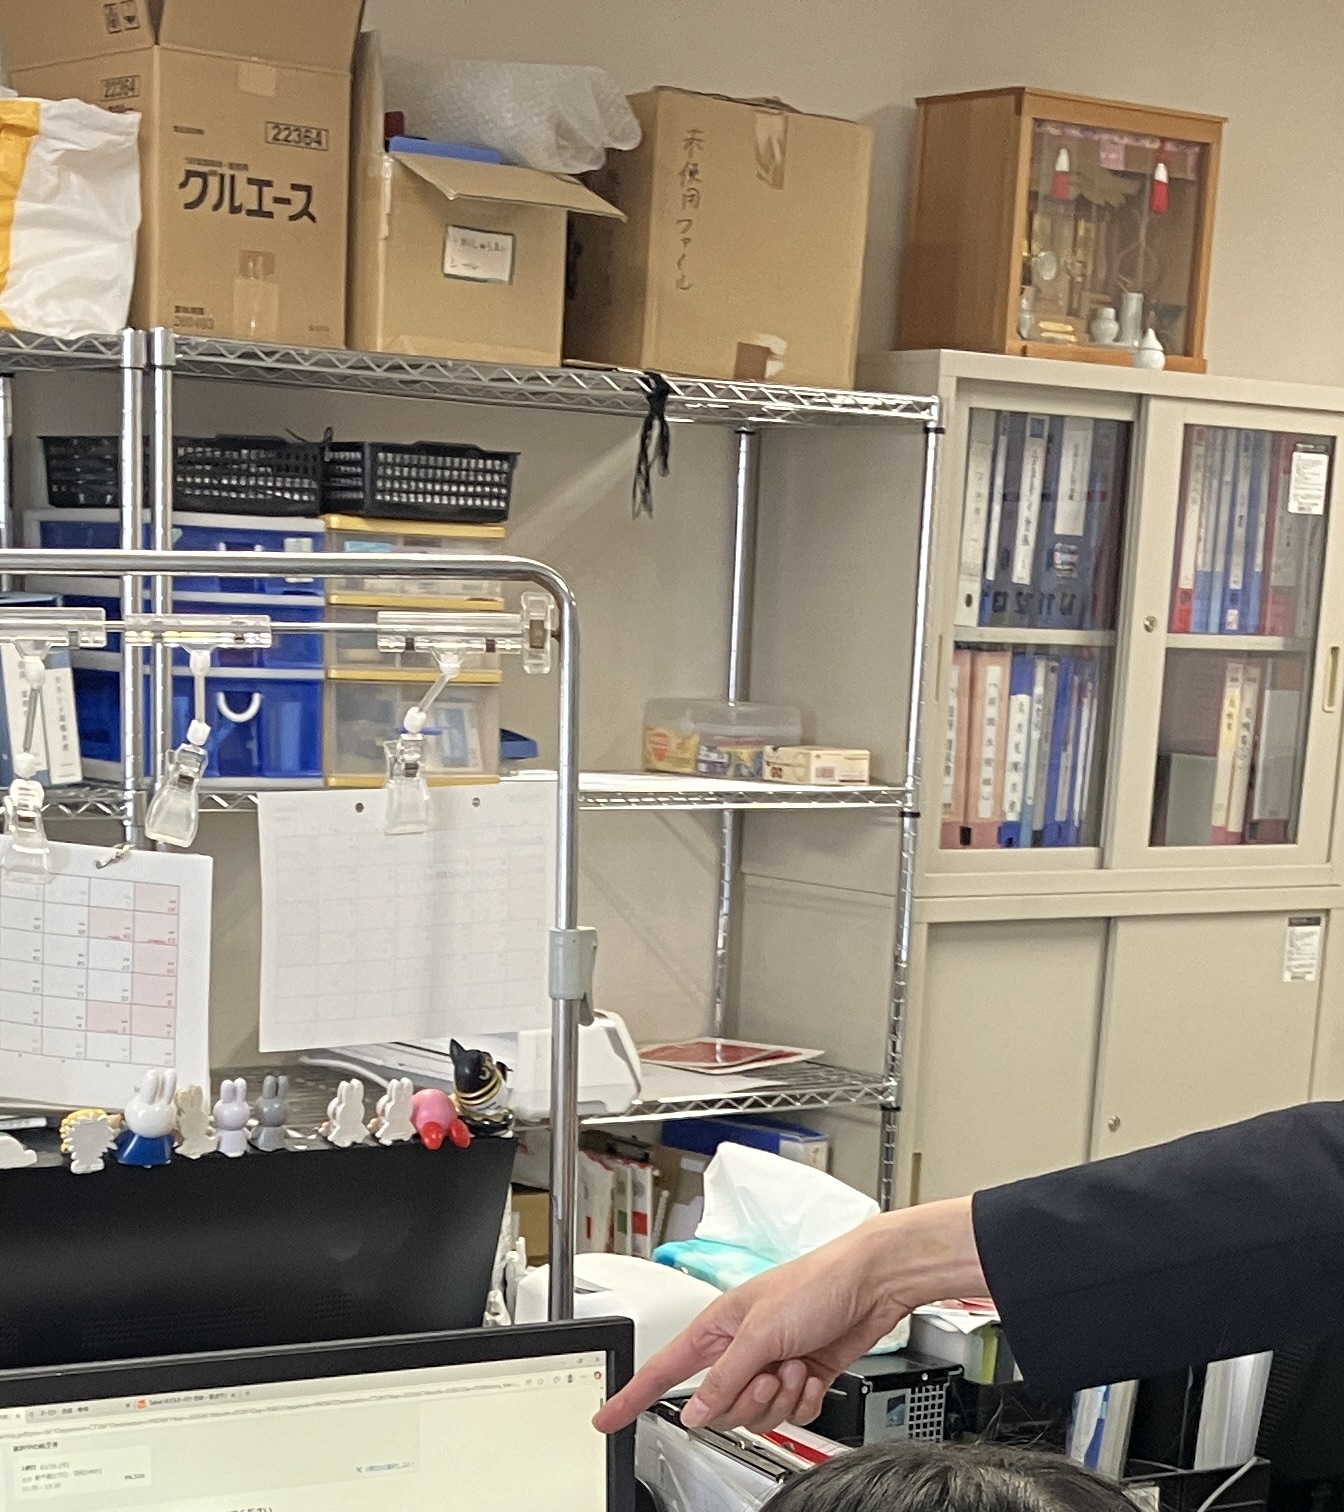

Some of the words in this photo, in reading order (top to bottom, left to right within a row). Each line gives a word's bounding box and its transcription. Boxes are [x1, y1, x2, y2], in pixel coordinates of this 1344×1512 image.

[178, 168, 318, 224] グルエース
